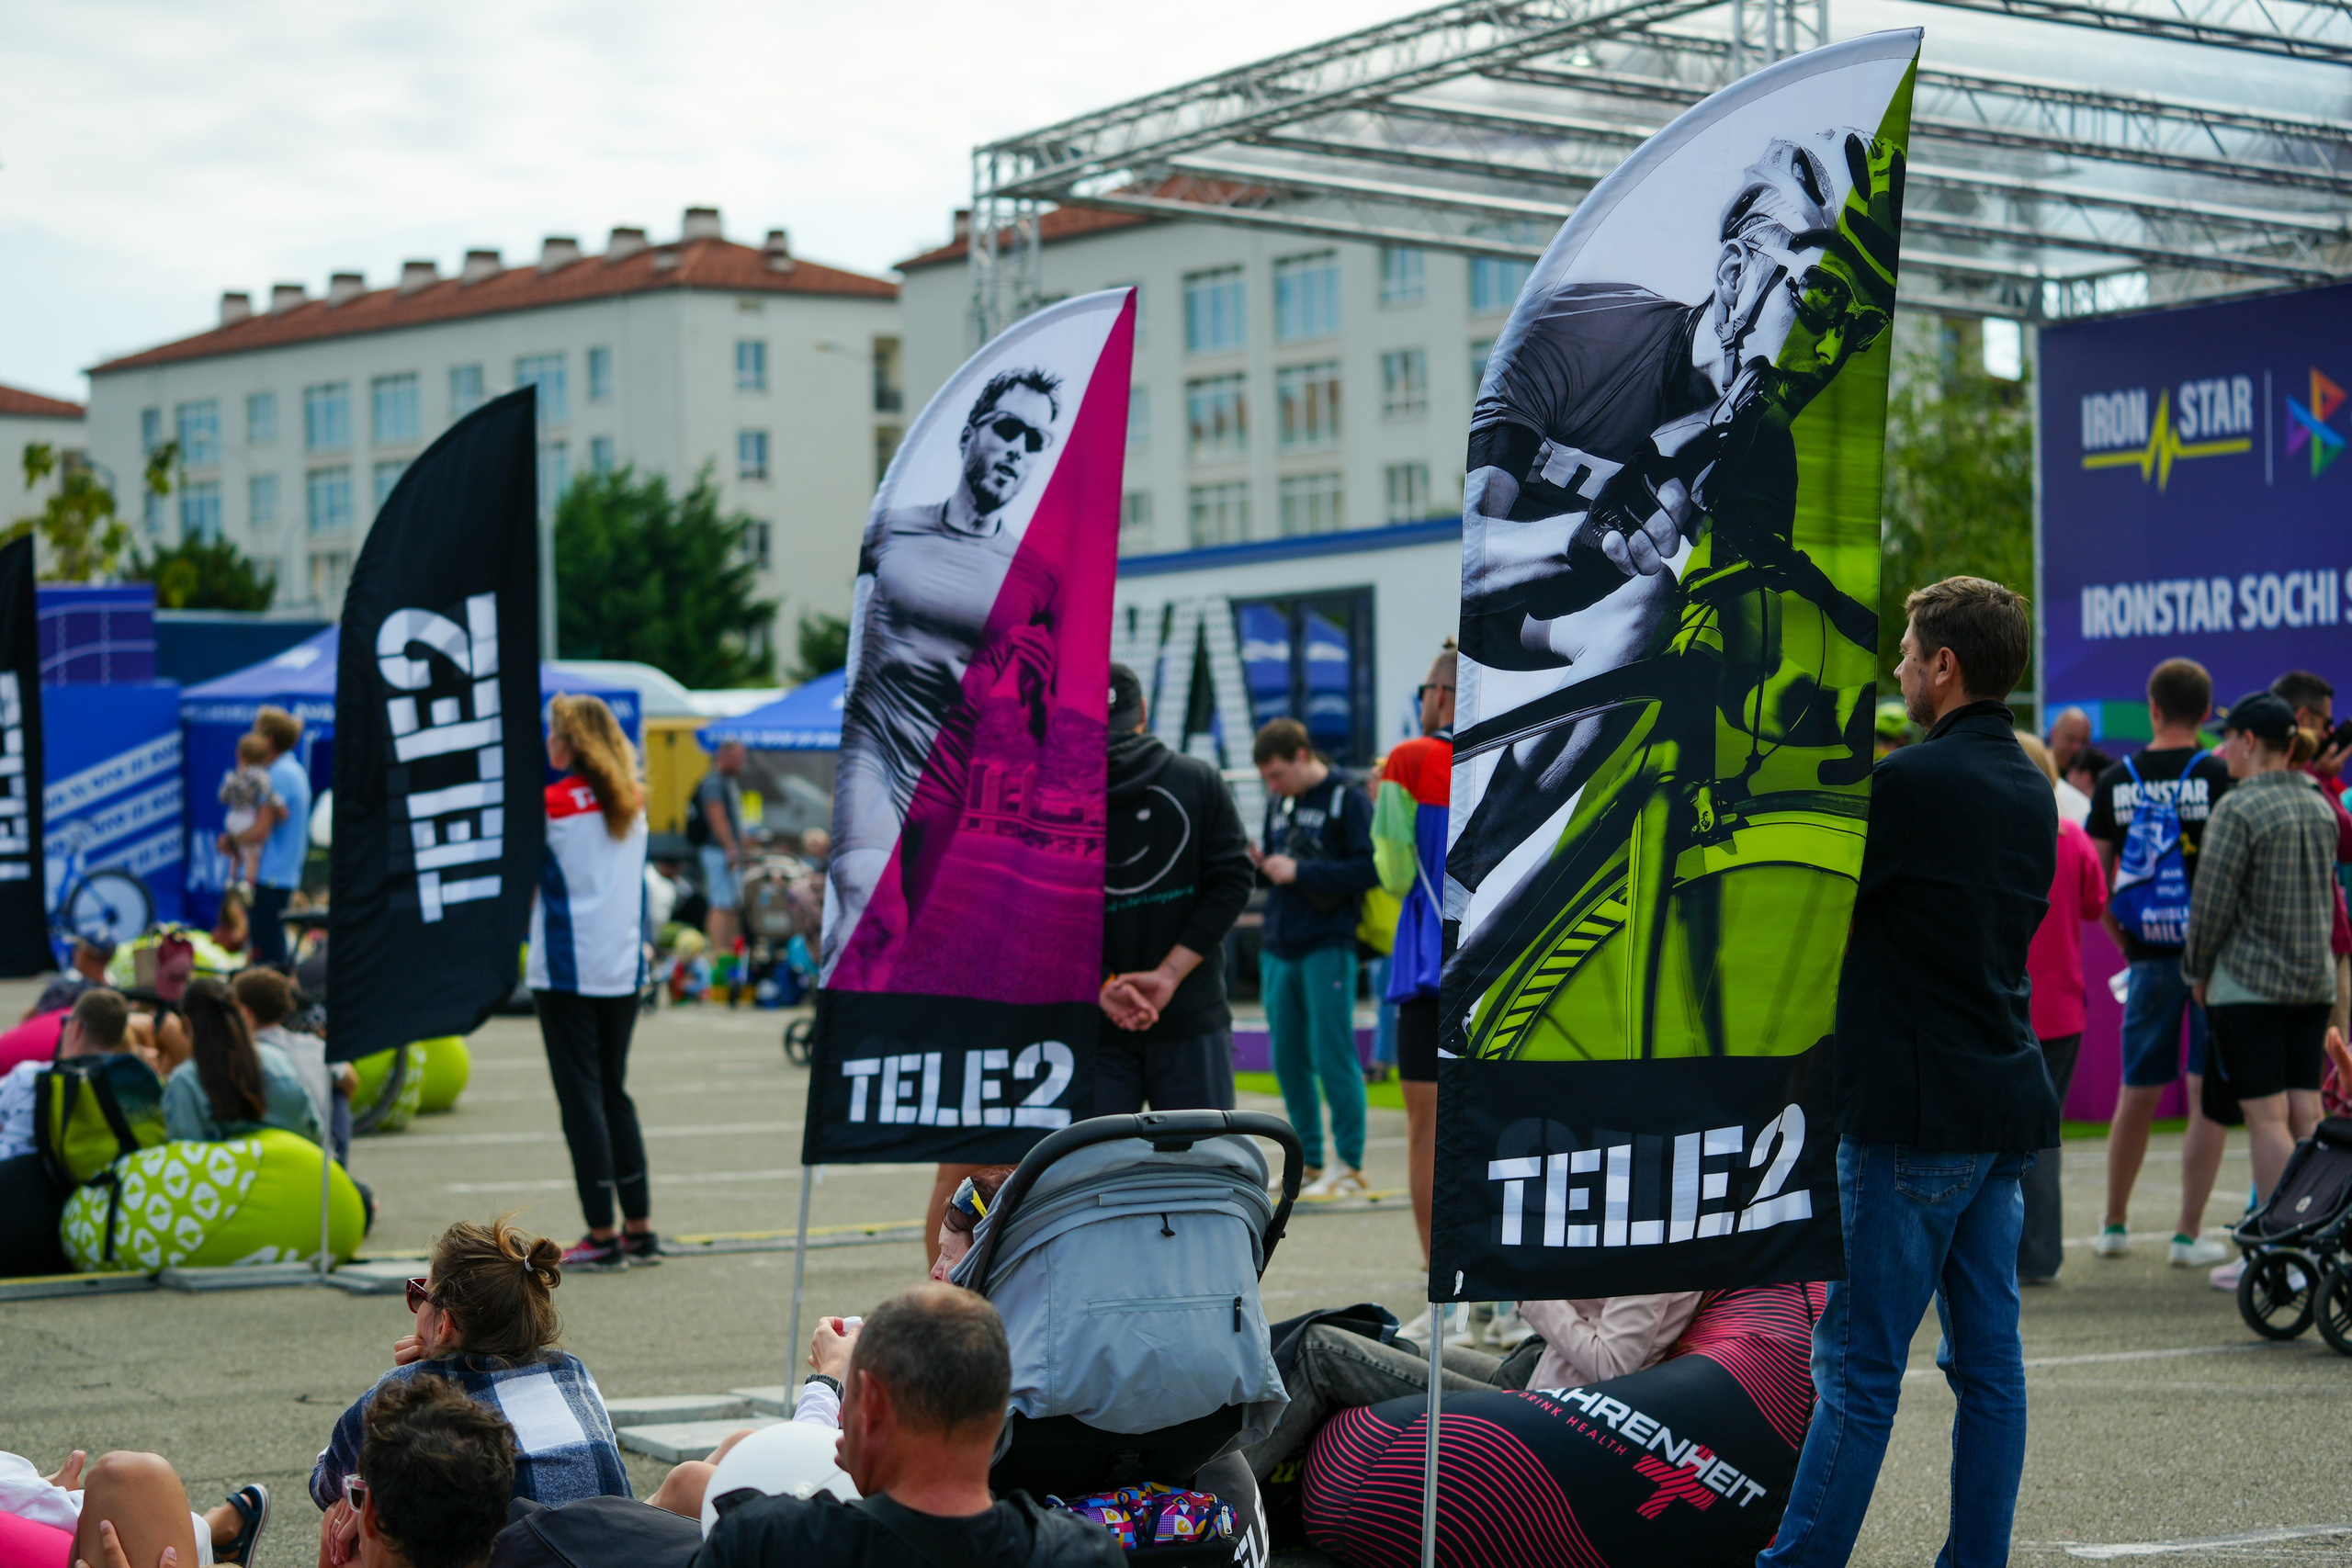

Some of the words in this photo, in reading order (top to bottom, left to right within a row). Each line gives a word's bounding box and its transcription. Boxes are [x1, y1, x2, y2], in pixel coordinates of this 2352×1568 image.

[2082, 389, 2147, 450] IRON
[2179, 376, 2252, 438] STAR
[2082, 580, 2233, 638] IRONSTAR
[2239, 570, 2338, 630] SOCHI
[376, 591, 504, 923] TELE2
[841, 1040, 1075, 1130] TELE2
[1487, 1103, 1813, 1247] TELE2
[1518, 1391, 1564, 1417] DRINK
[1566, 1416, 1629, 1457] HEALTH
[1535, 1387, 1767, 1508] AHRENHEIT
